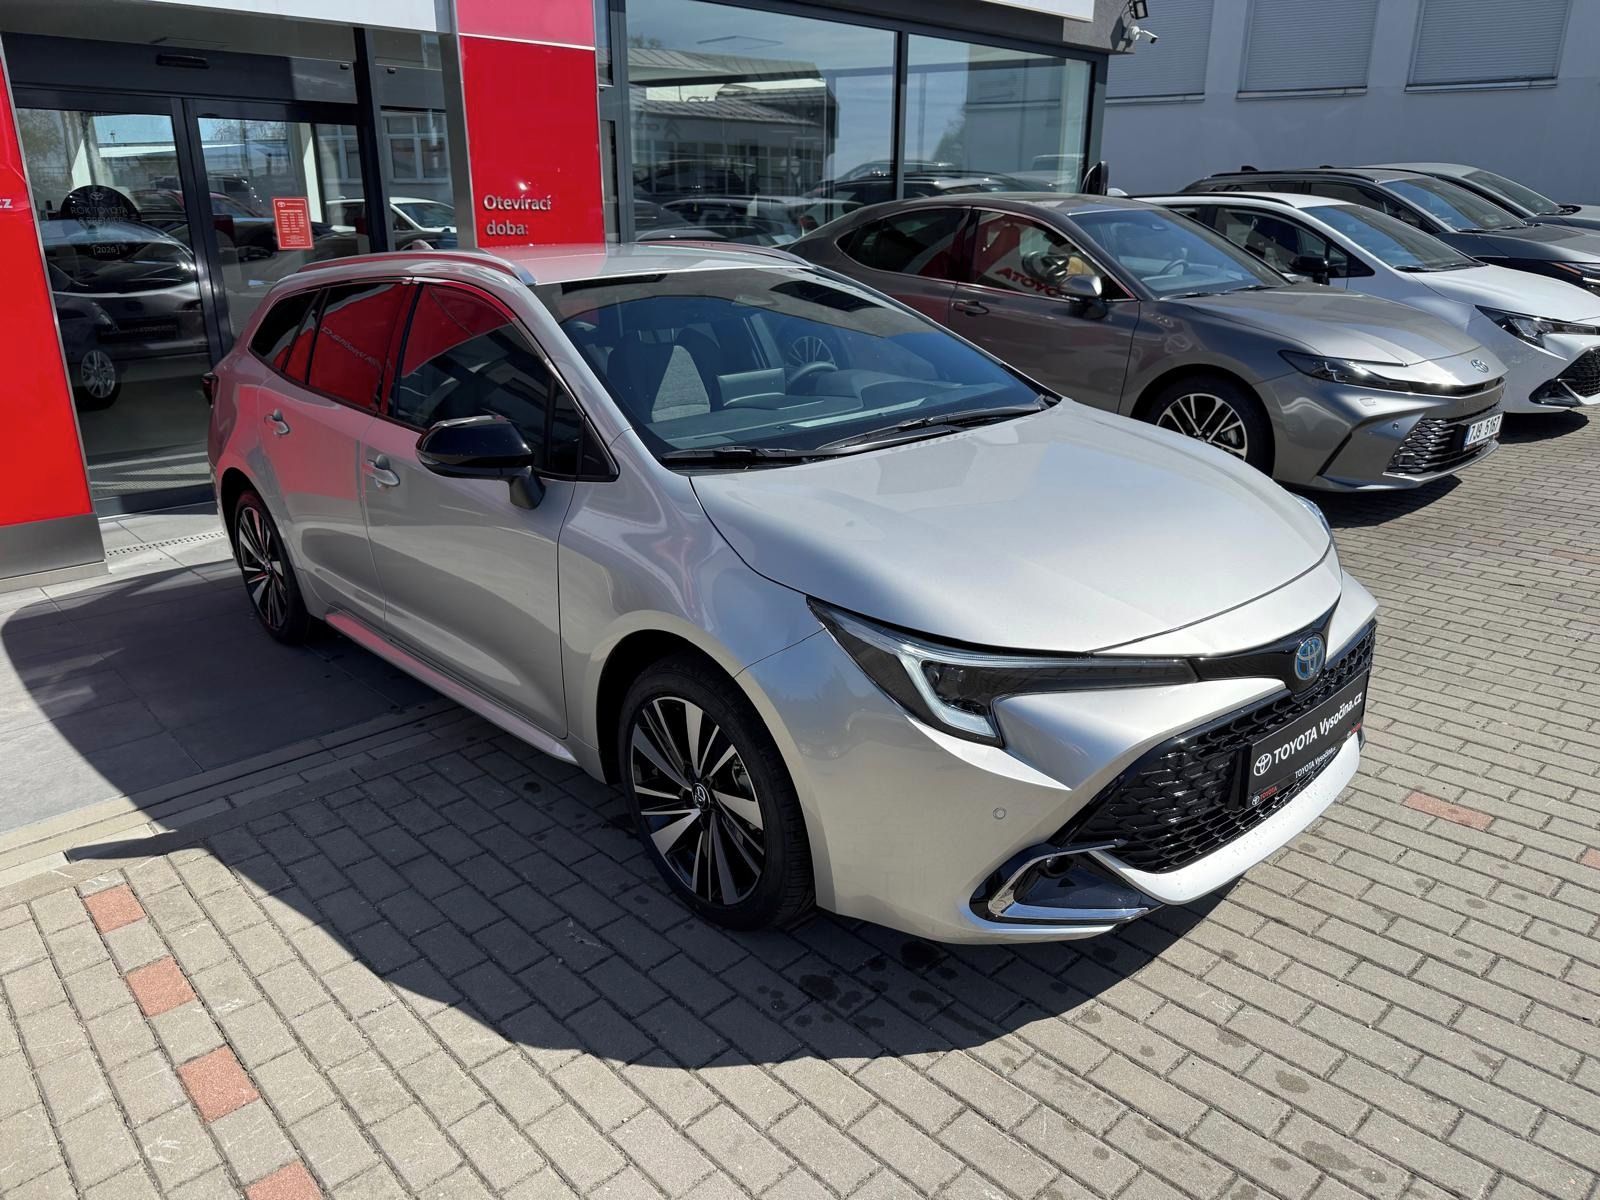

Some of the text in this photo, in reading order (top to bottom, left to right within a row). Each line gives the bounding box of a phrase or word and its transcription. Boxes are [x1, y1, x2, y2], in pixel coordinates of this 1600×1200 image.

[483, 194, 552, 210] Otevírací
[486, 219, 529, 235] doba:
[1273, 692, 1362, 764] TOYOTA Vysočina.cz
[1295, 761, 1315, 778] TOYOTA
